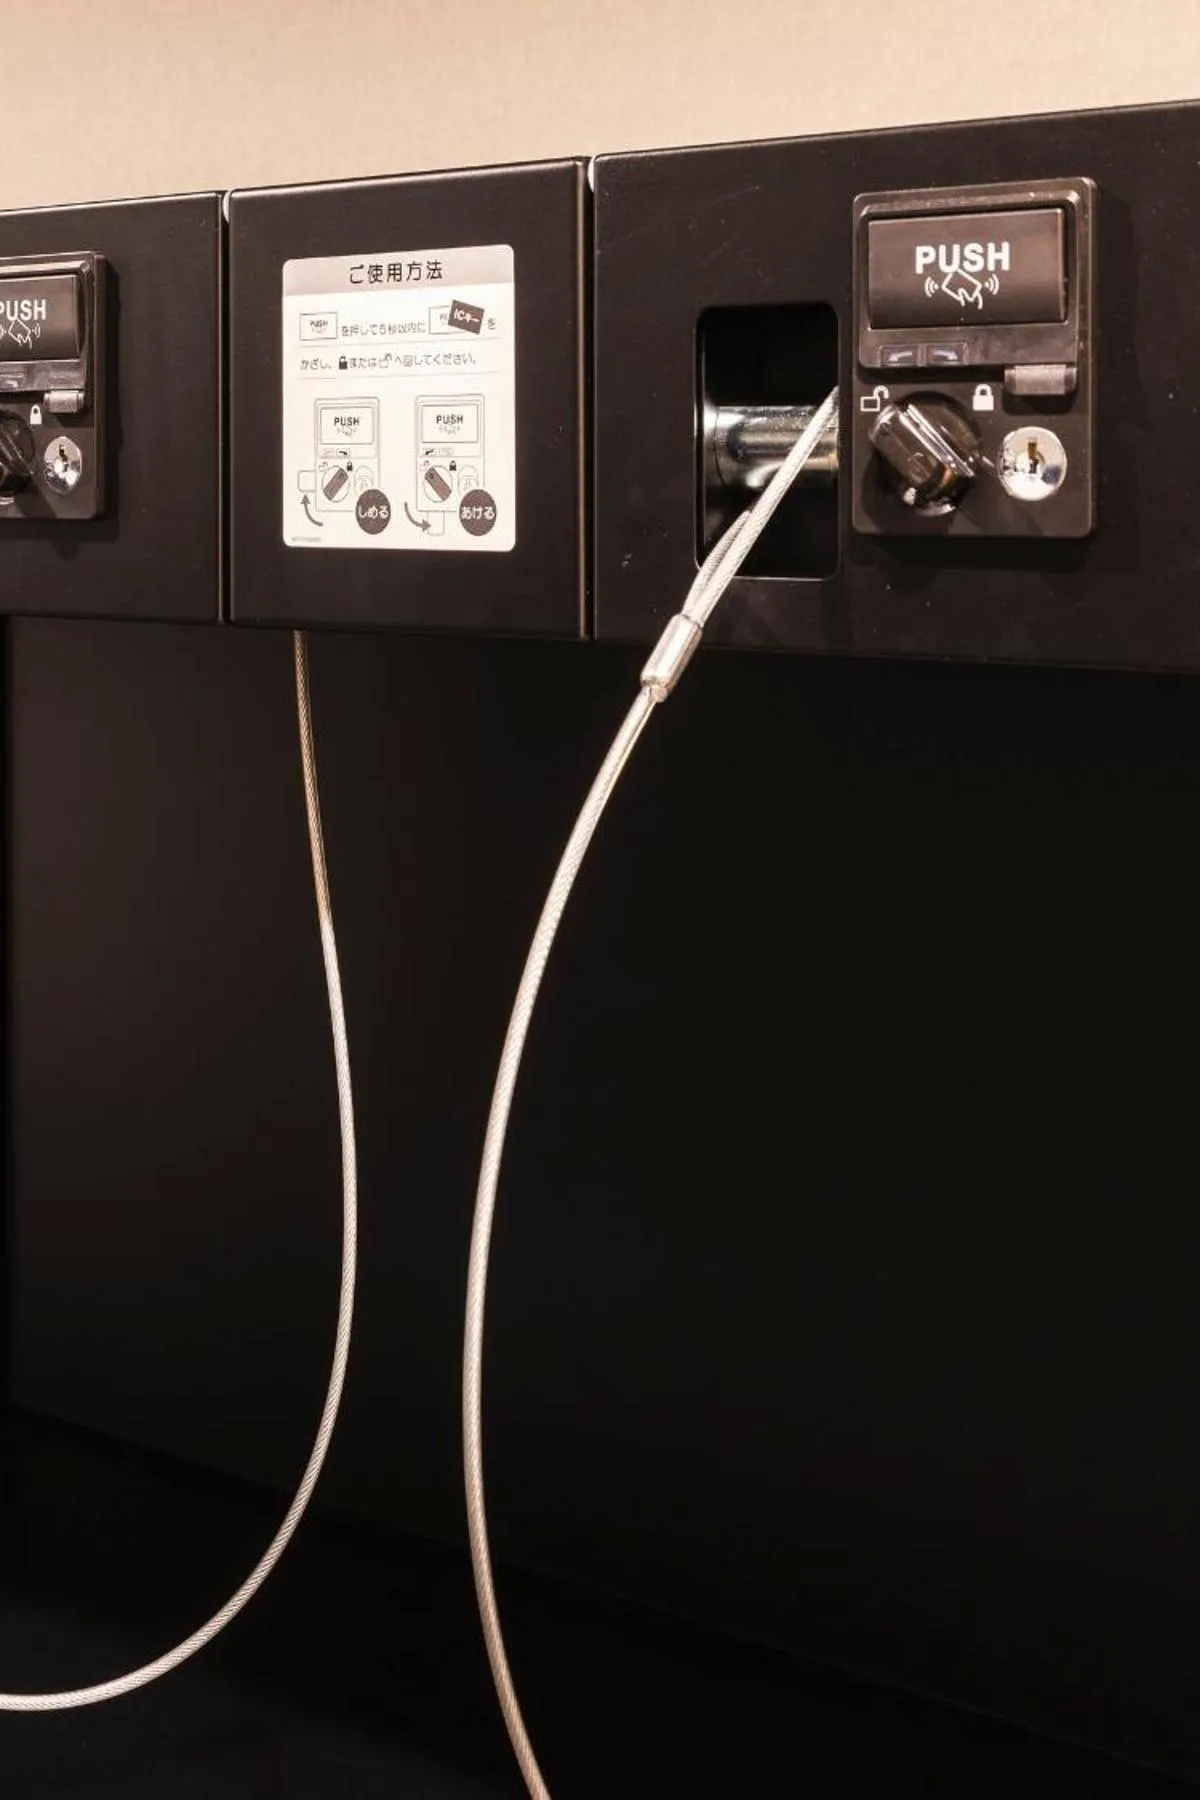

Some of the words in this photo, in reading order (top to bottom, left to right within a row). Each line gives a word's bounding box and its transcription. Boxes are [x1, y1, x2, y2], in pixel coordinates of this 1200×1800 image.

[915, 241, 1011, 274] PUSH
[349, 260, 443, 284] ご使用方法
[453, 308, 481, 323] ICキー
[333, 416, 360, 427] PUSH
[435, 414, 464, 425] PUSH
[357, 506, 389, 519] しめる
[460, 505, 495, 519] あける
